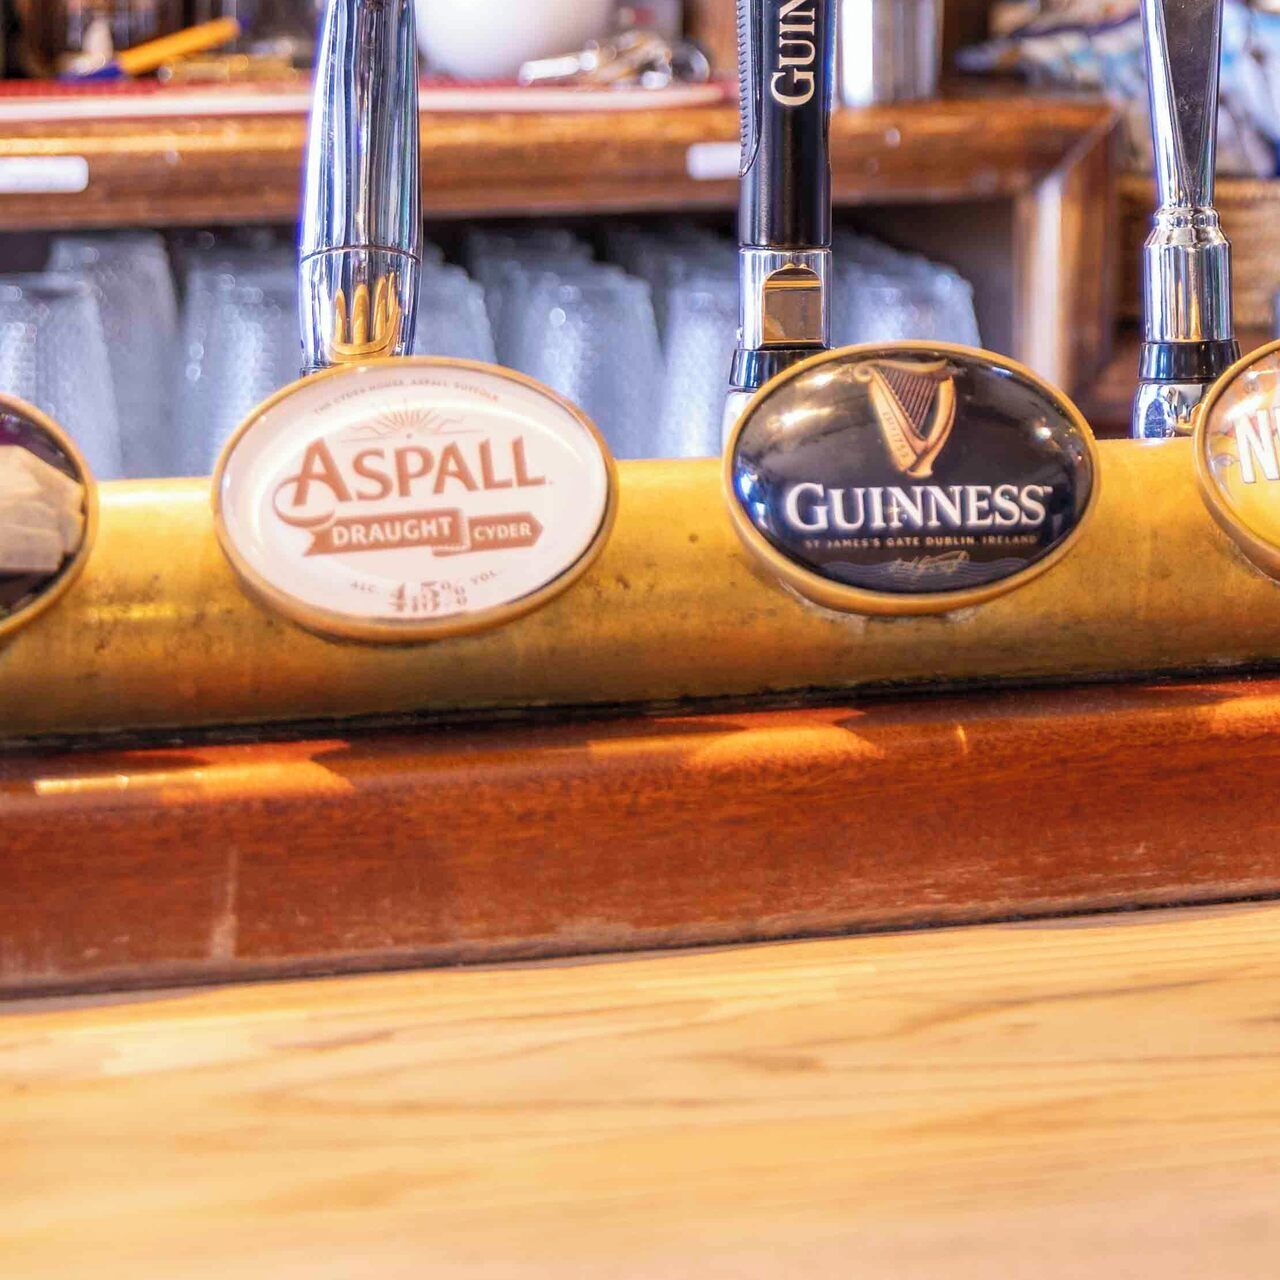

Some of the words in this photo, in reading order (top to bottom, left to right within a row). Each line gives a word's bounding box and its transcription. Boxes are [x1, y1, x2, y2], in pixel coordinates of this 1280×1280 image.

[273, 436, 546, 512] ASPALL
[785, 482, 1046, 532] GUINNESS
[331, 517, 452, 546] DRAUGHT
[474, 522, 532, 541] CYDER
[886, 536, 920, 547] GATE
[982, 534, 1038, 545] IRELAND
